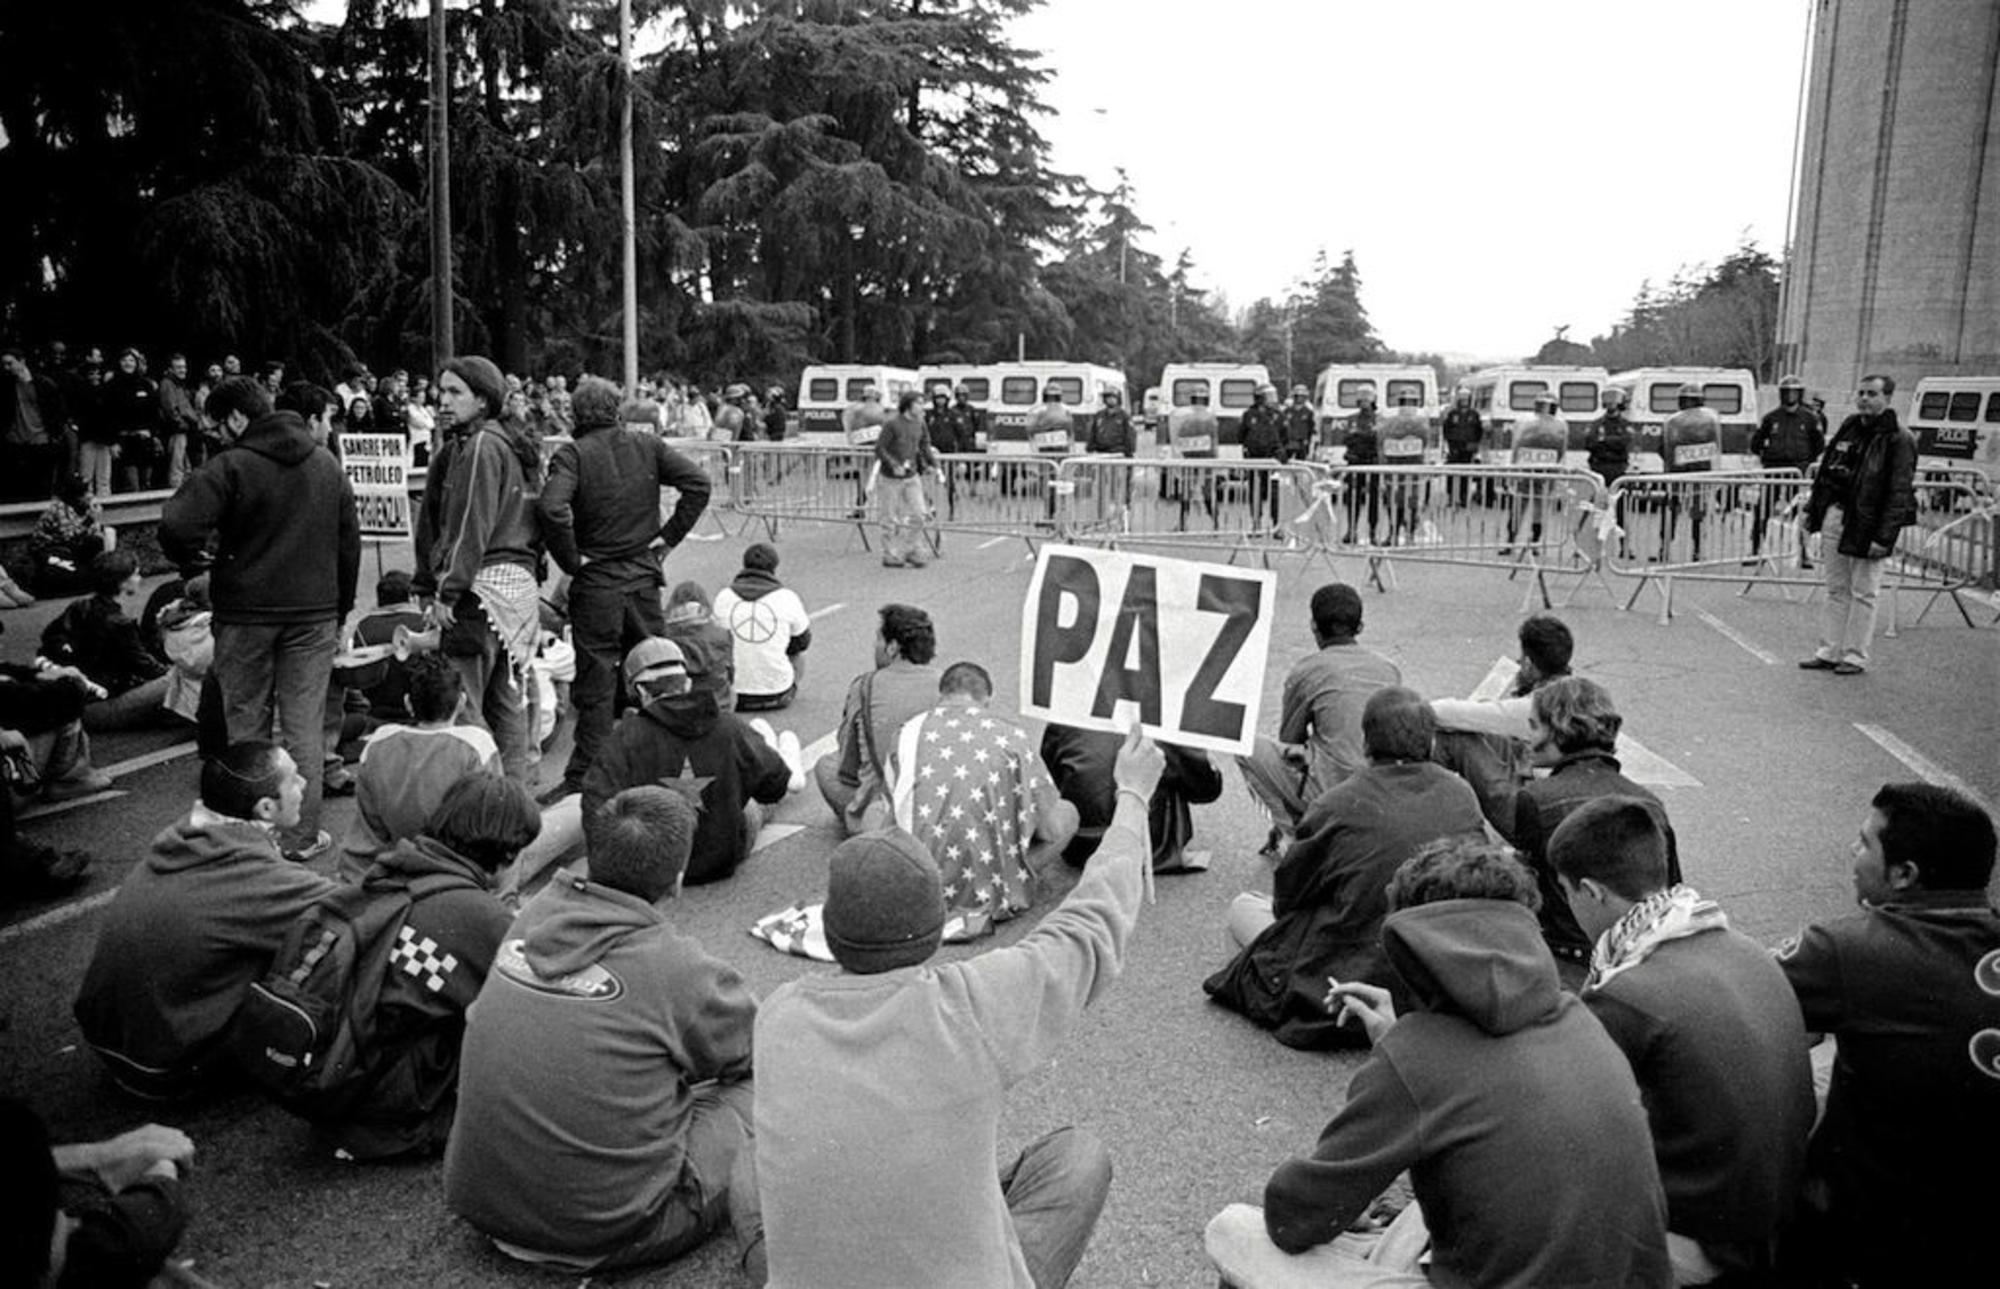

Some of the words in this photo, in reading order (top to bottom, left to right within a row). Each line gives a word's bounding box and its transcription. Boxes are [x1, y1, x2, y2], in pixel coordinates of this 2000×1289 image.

[1937, 427, 1970, 441] POLICIA
[343, 438, 380, 456] SANGRE
[382, 438, 401, 456] POR
[346, 461, 402, 484] PETRÓLEO
[1032, 554, 1262, 742] PAZ
